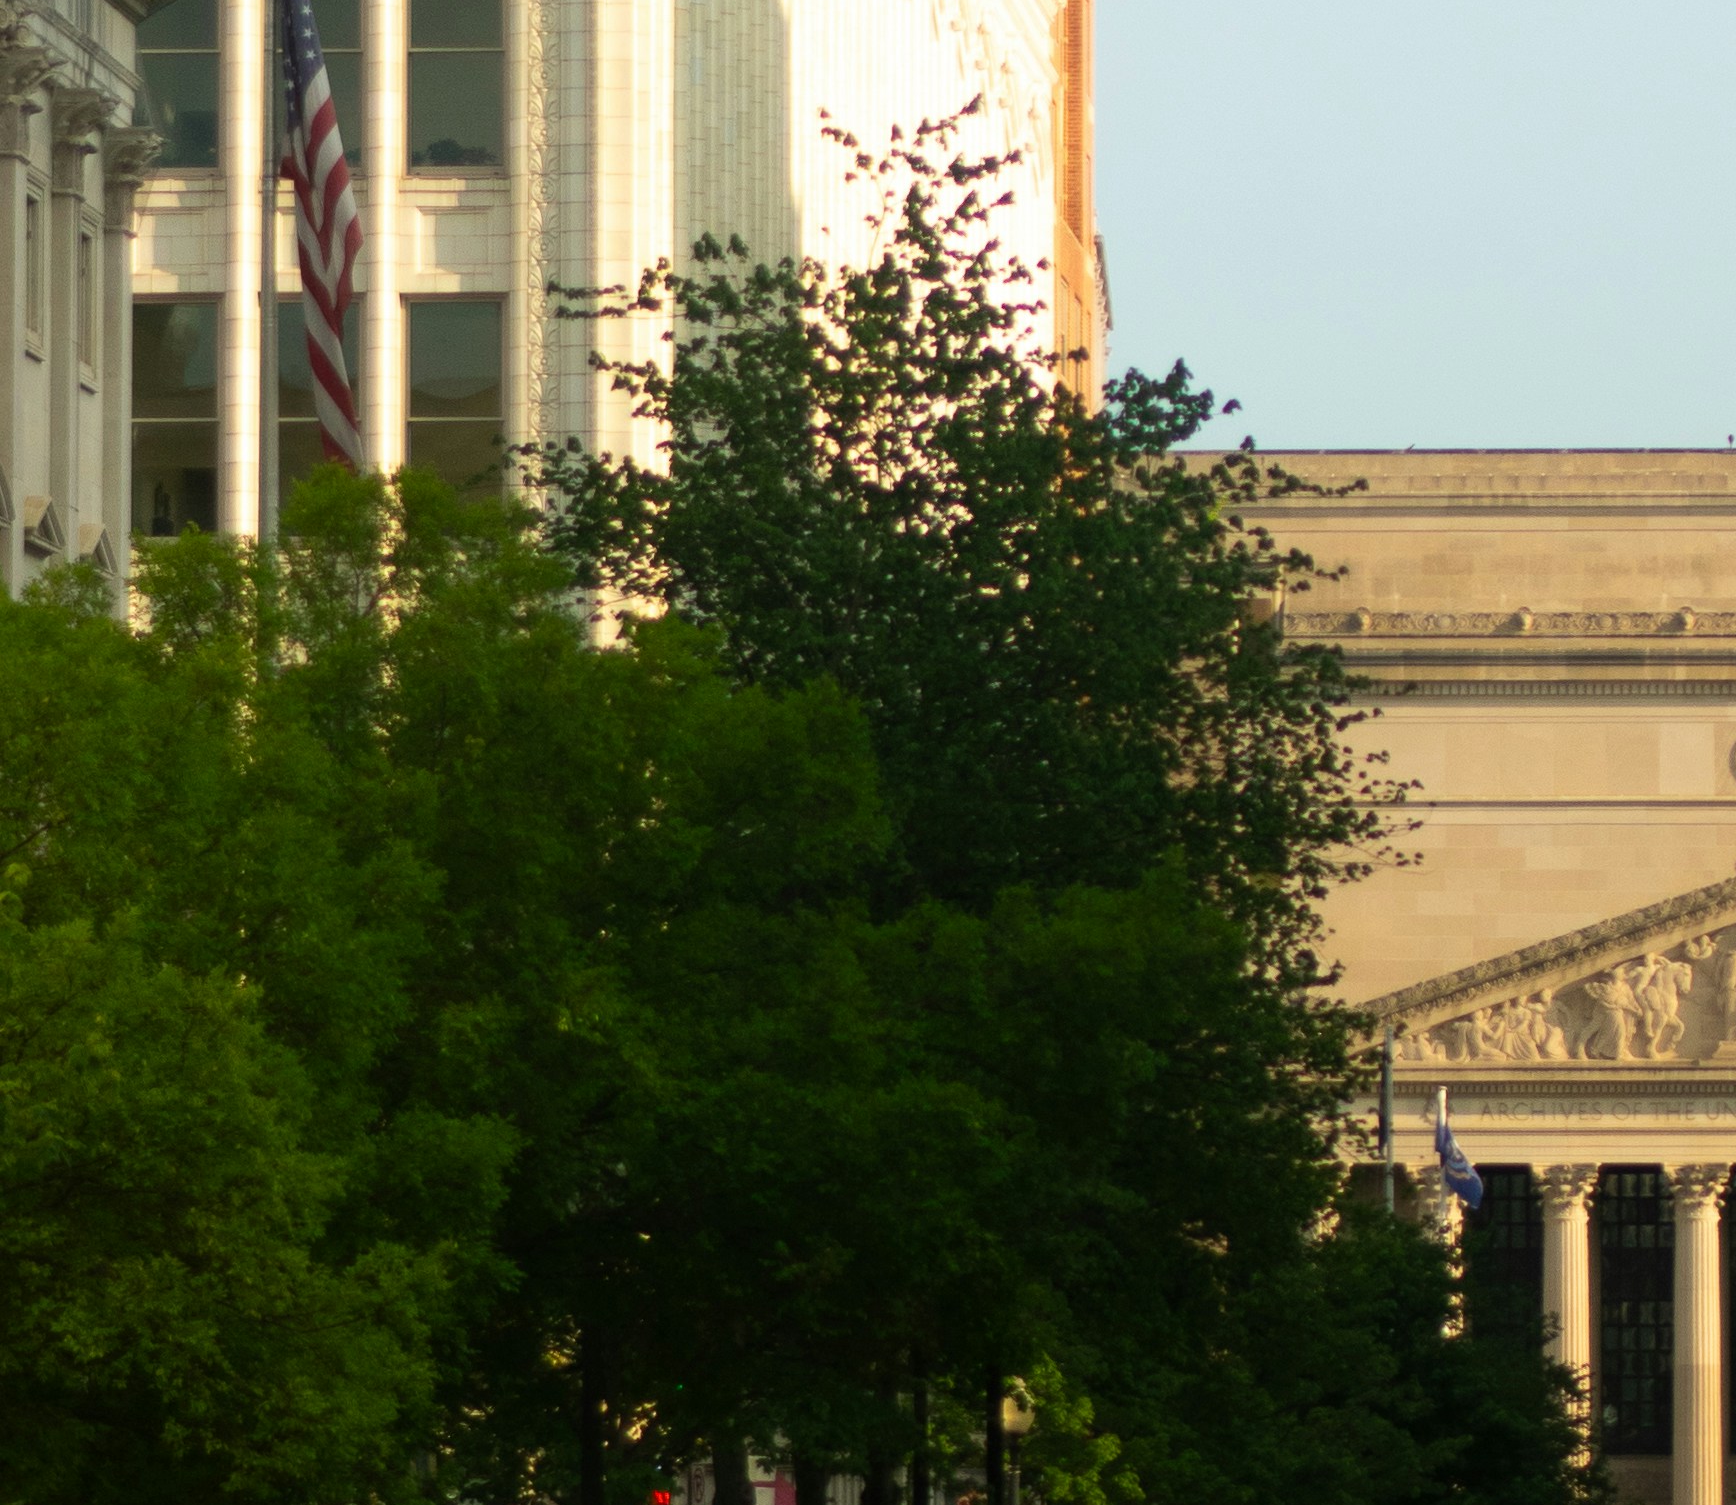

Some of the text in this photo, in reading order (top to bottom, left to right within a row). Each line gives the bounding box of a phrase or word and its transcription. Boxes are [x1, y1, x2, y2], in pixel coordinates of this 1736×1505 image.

[1479, 1101, 1604, 1121] ARCHIVES
[1611, 1101, 1646, 1121] OF
[1649, 1101, 1696, 1121] THE
